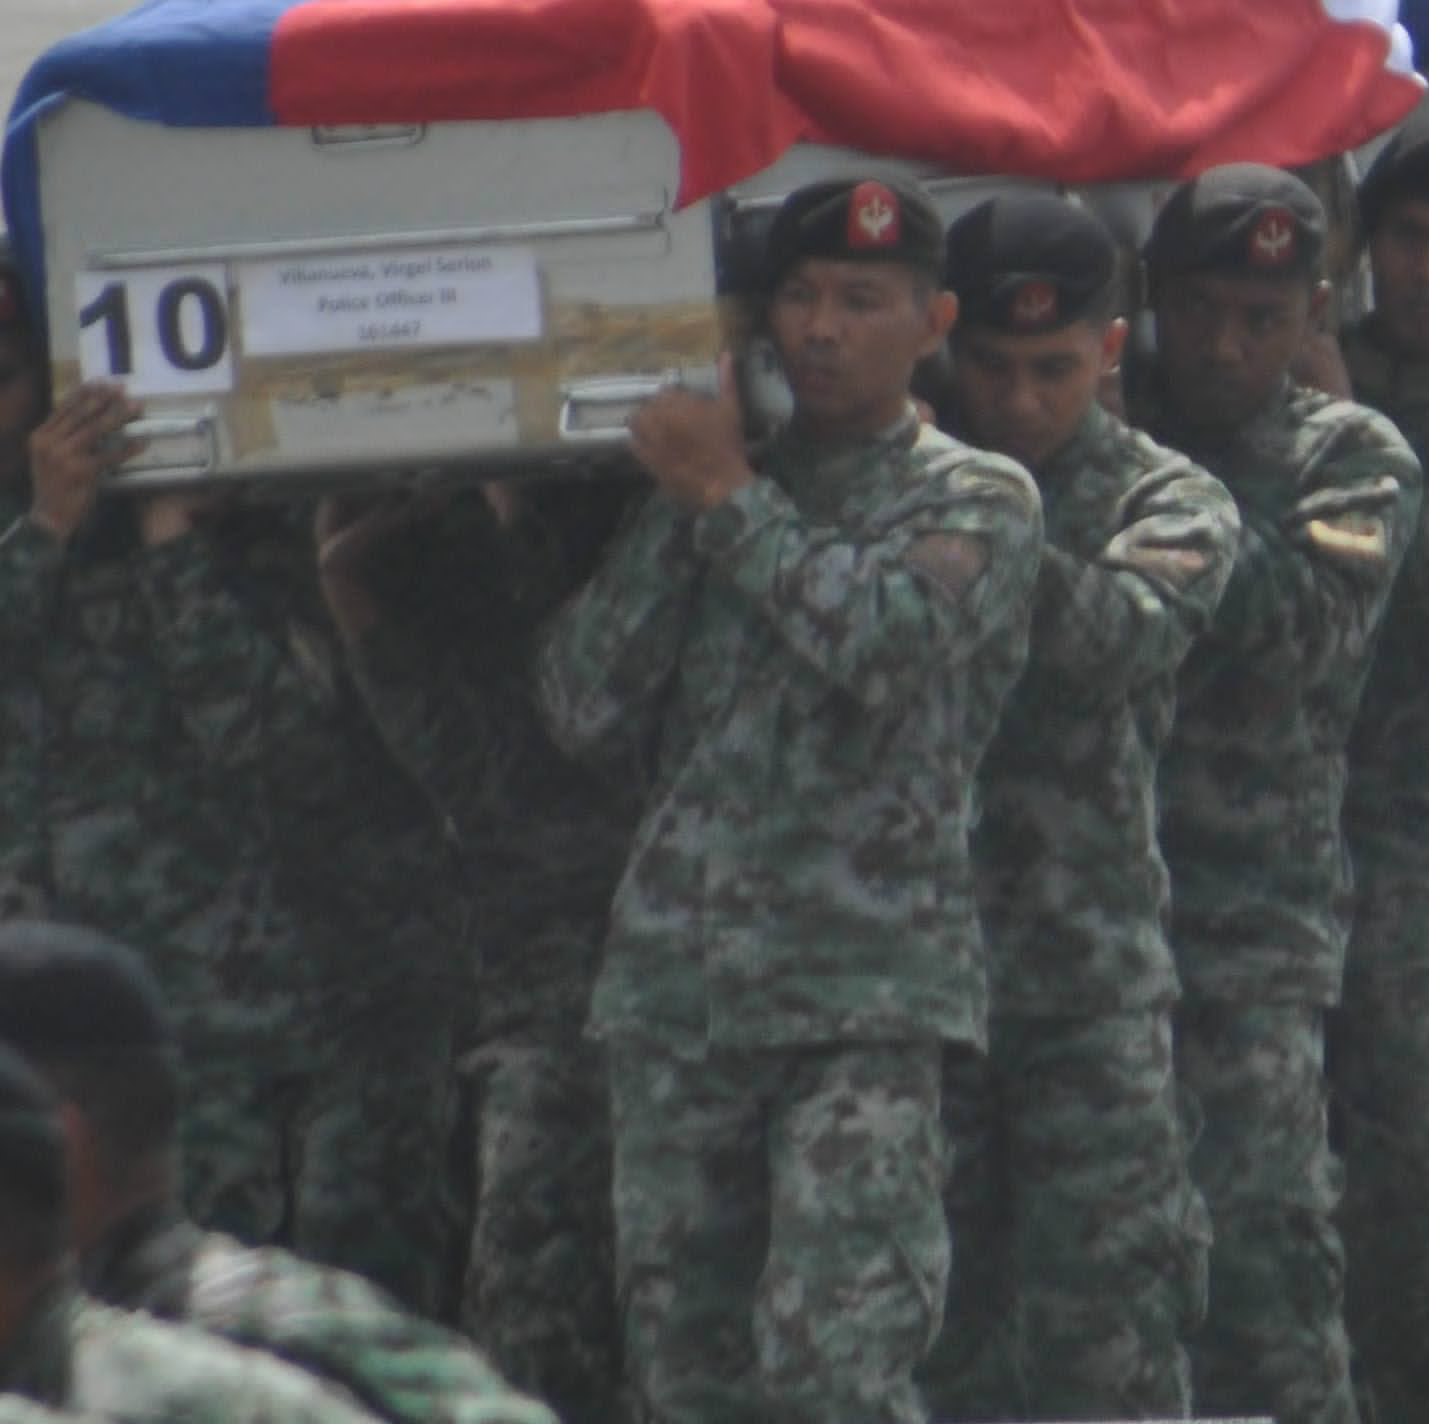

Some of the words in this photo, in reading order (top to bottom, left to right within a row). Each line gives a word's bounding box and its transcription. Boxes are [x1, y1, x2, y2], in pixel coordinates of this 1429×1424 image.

[79, 278, 227, 375] 10
[317, 294, 369, 314] Police
[375, 287, 433, 309] Officer
